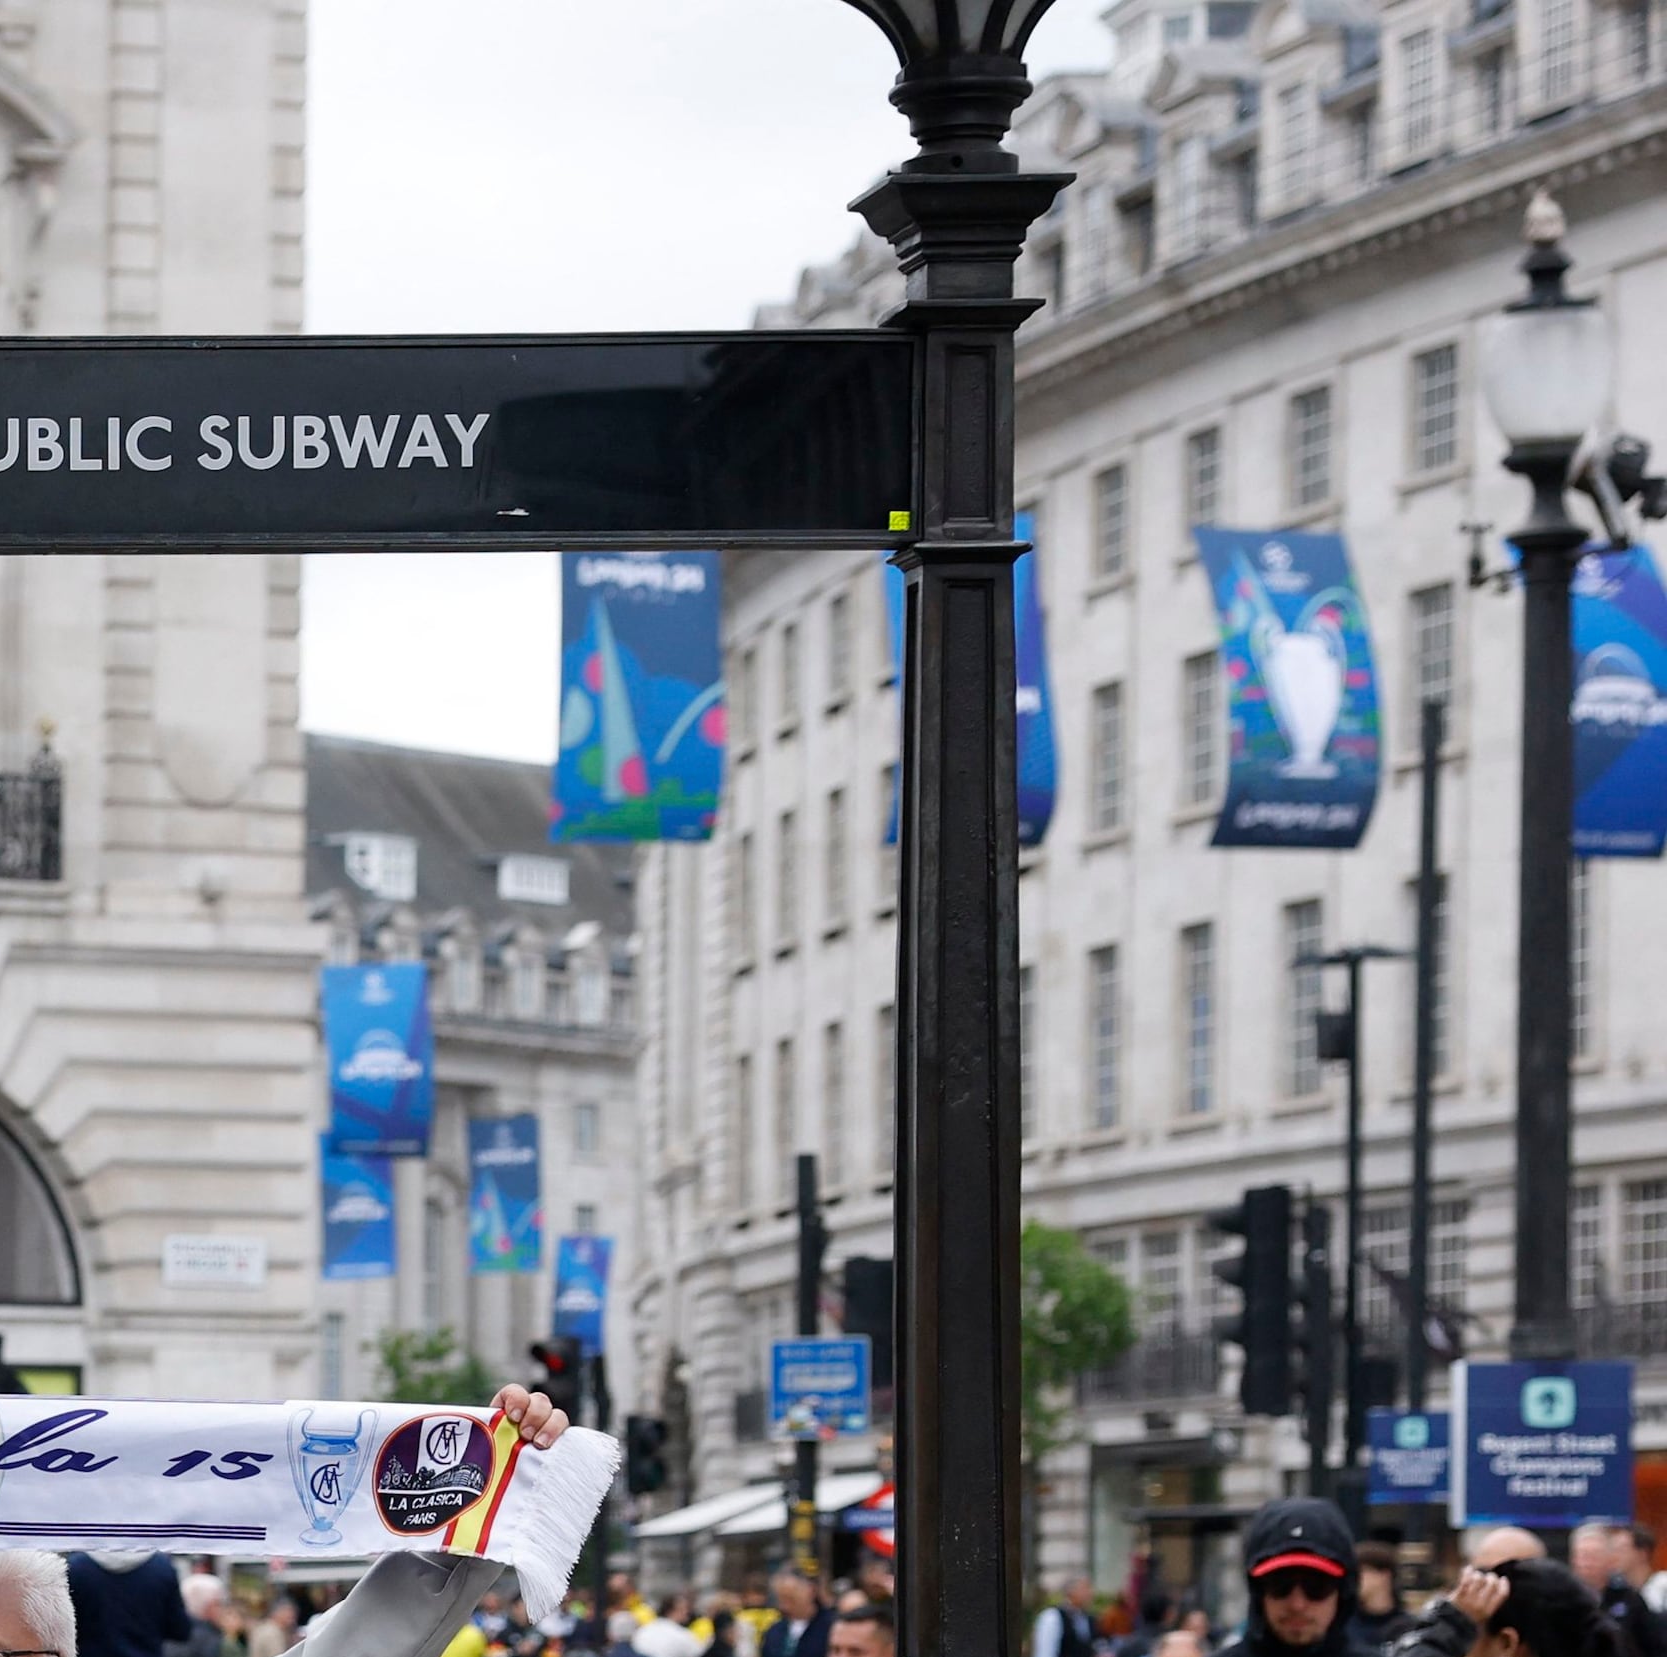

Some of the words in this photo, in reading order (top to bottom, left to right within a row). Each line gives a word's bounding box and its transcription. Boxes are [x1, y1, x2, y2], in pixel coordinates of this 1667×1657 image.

[197, 414, 490, 471] SUBWAY
[162, 1449, 274, 1481] 15
[389, 1497, 408, 1511] LA
[403, 1512, 438, 1525] FANS
